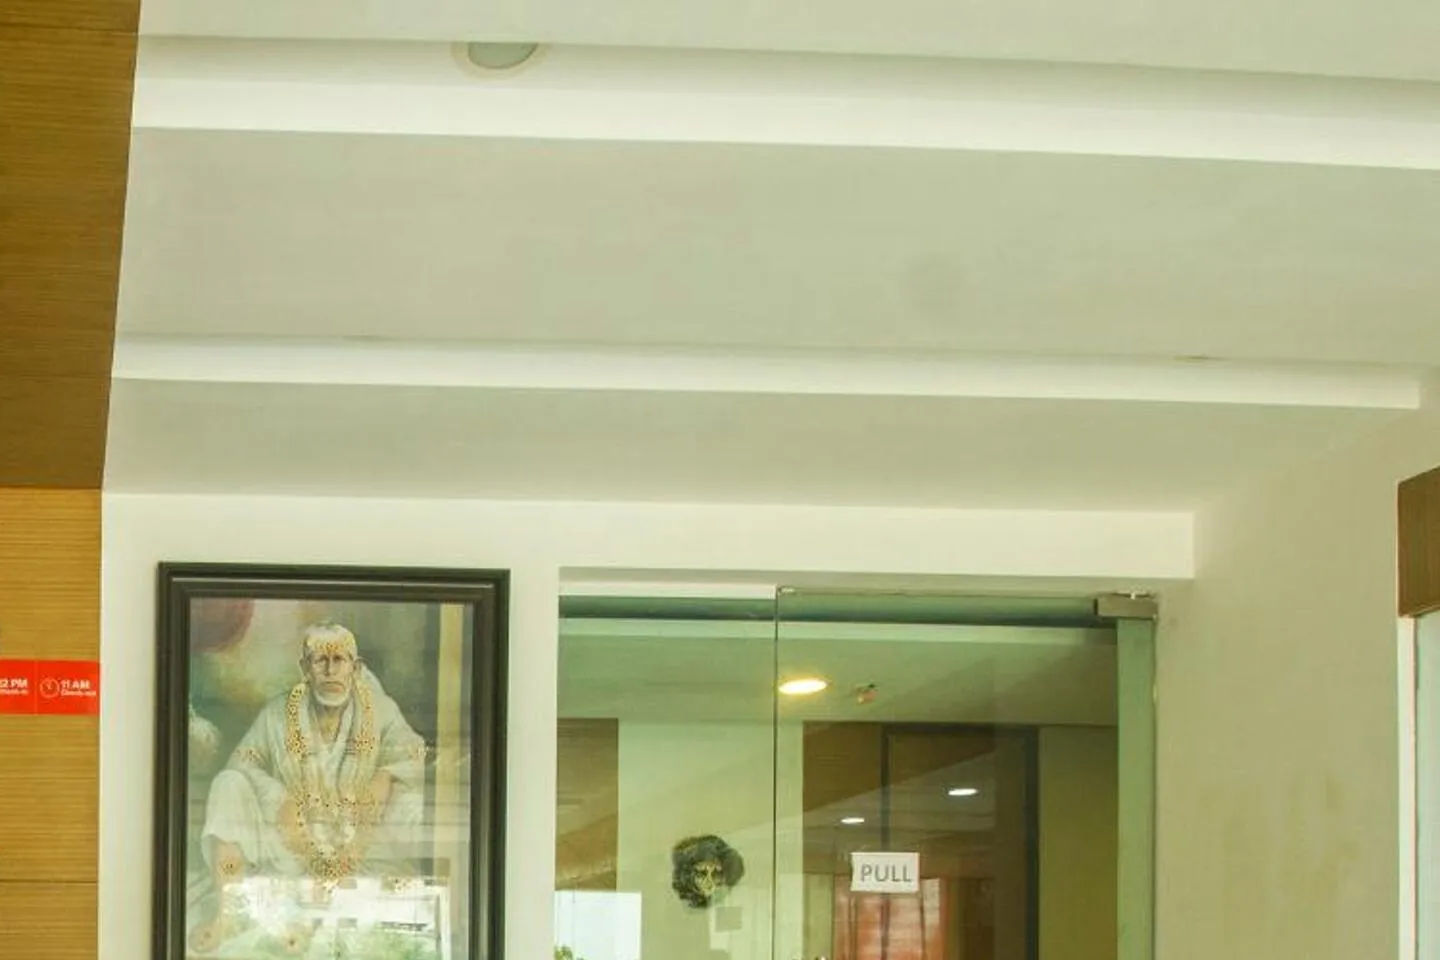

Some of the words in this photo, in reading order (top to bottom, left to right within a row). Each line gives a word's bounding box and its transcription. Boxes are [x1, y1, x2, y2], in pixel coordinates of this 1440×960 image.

[10, 678, 28, 688] PM
[71, 680, 91, 689] AM
[861, 864, 912, 882] PULL
